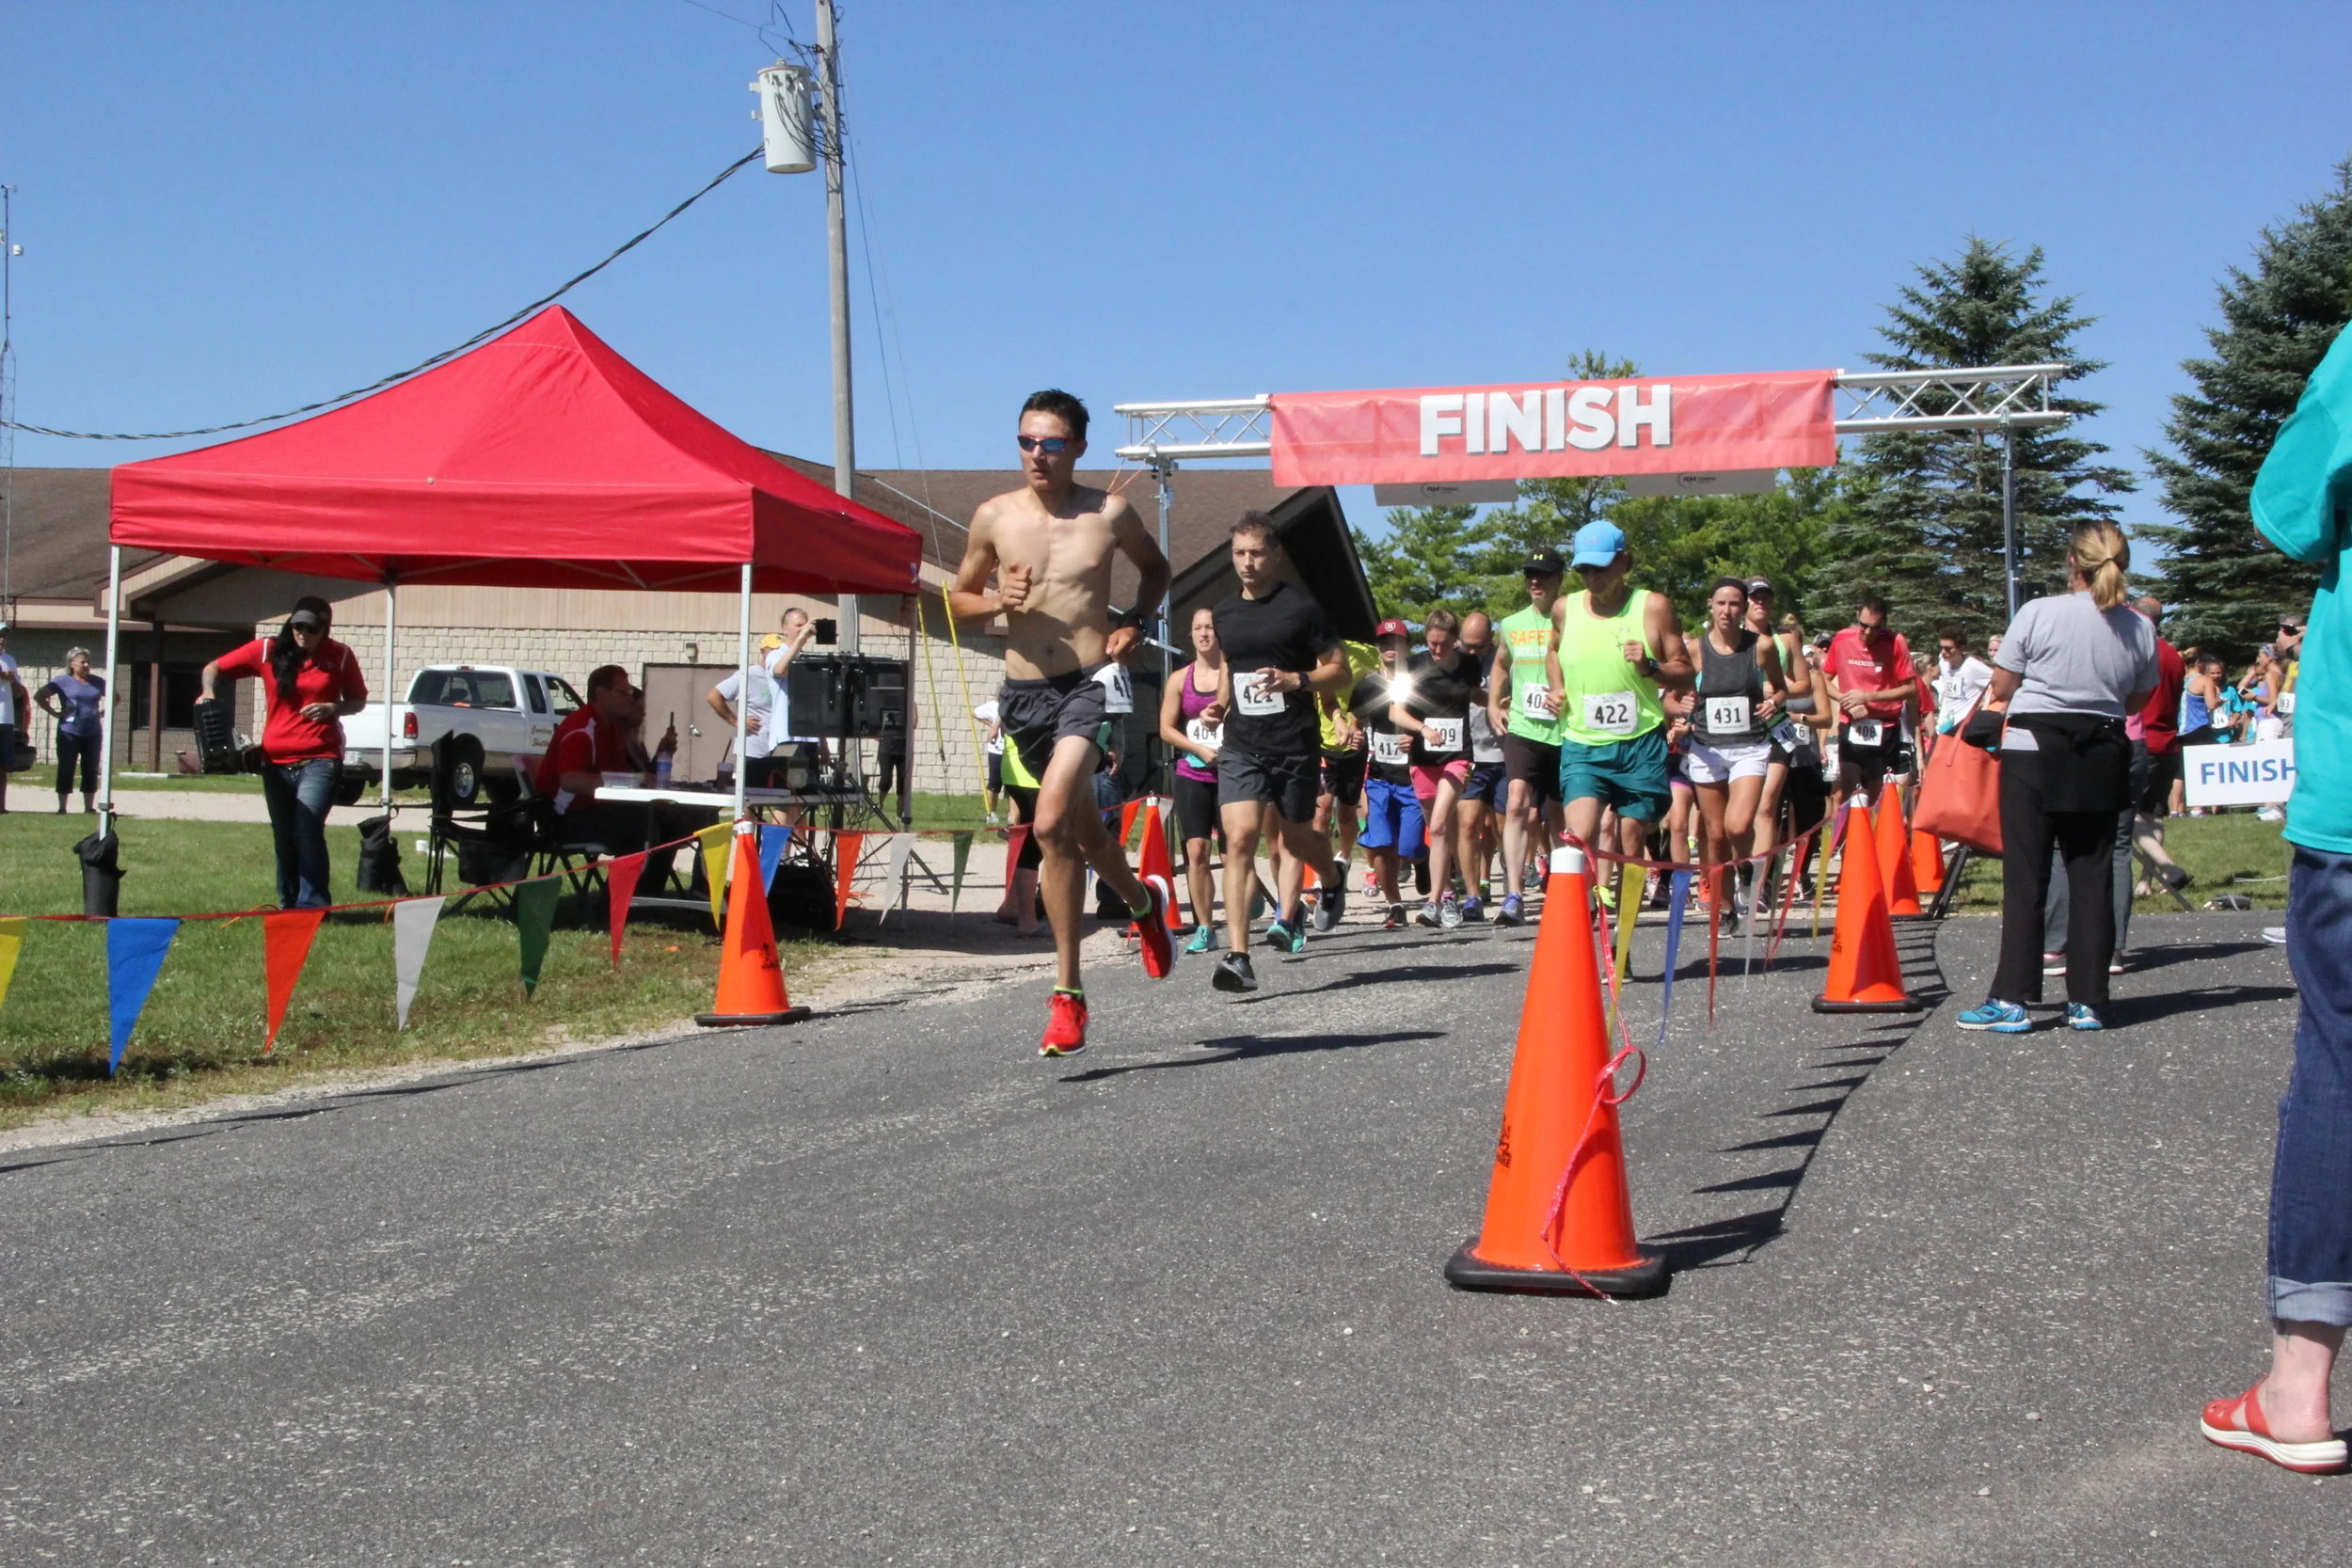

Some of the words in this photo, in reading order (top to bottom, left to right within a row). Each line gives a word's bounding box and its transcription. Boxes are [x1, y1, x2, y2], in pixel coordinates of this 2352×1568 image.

[1420, 383, 1672, 457] FINISH
[1595, 704, 1629, 724] 422
[1714, 706, 1741, 723] 431
[1193, 725, 1217, 740] 404
[1435, 727, 1455, 742] 09
[1379, 742, 1399, 756] 417
